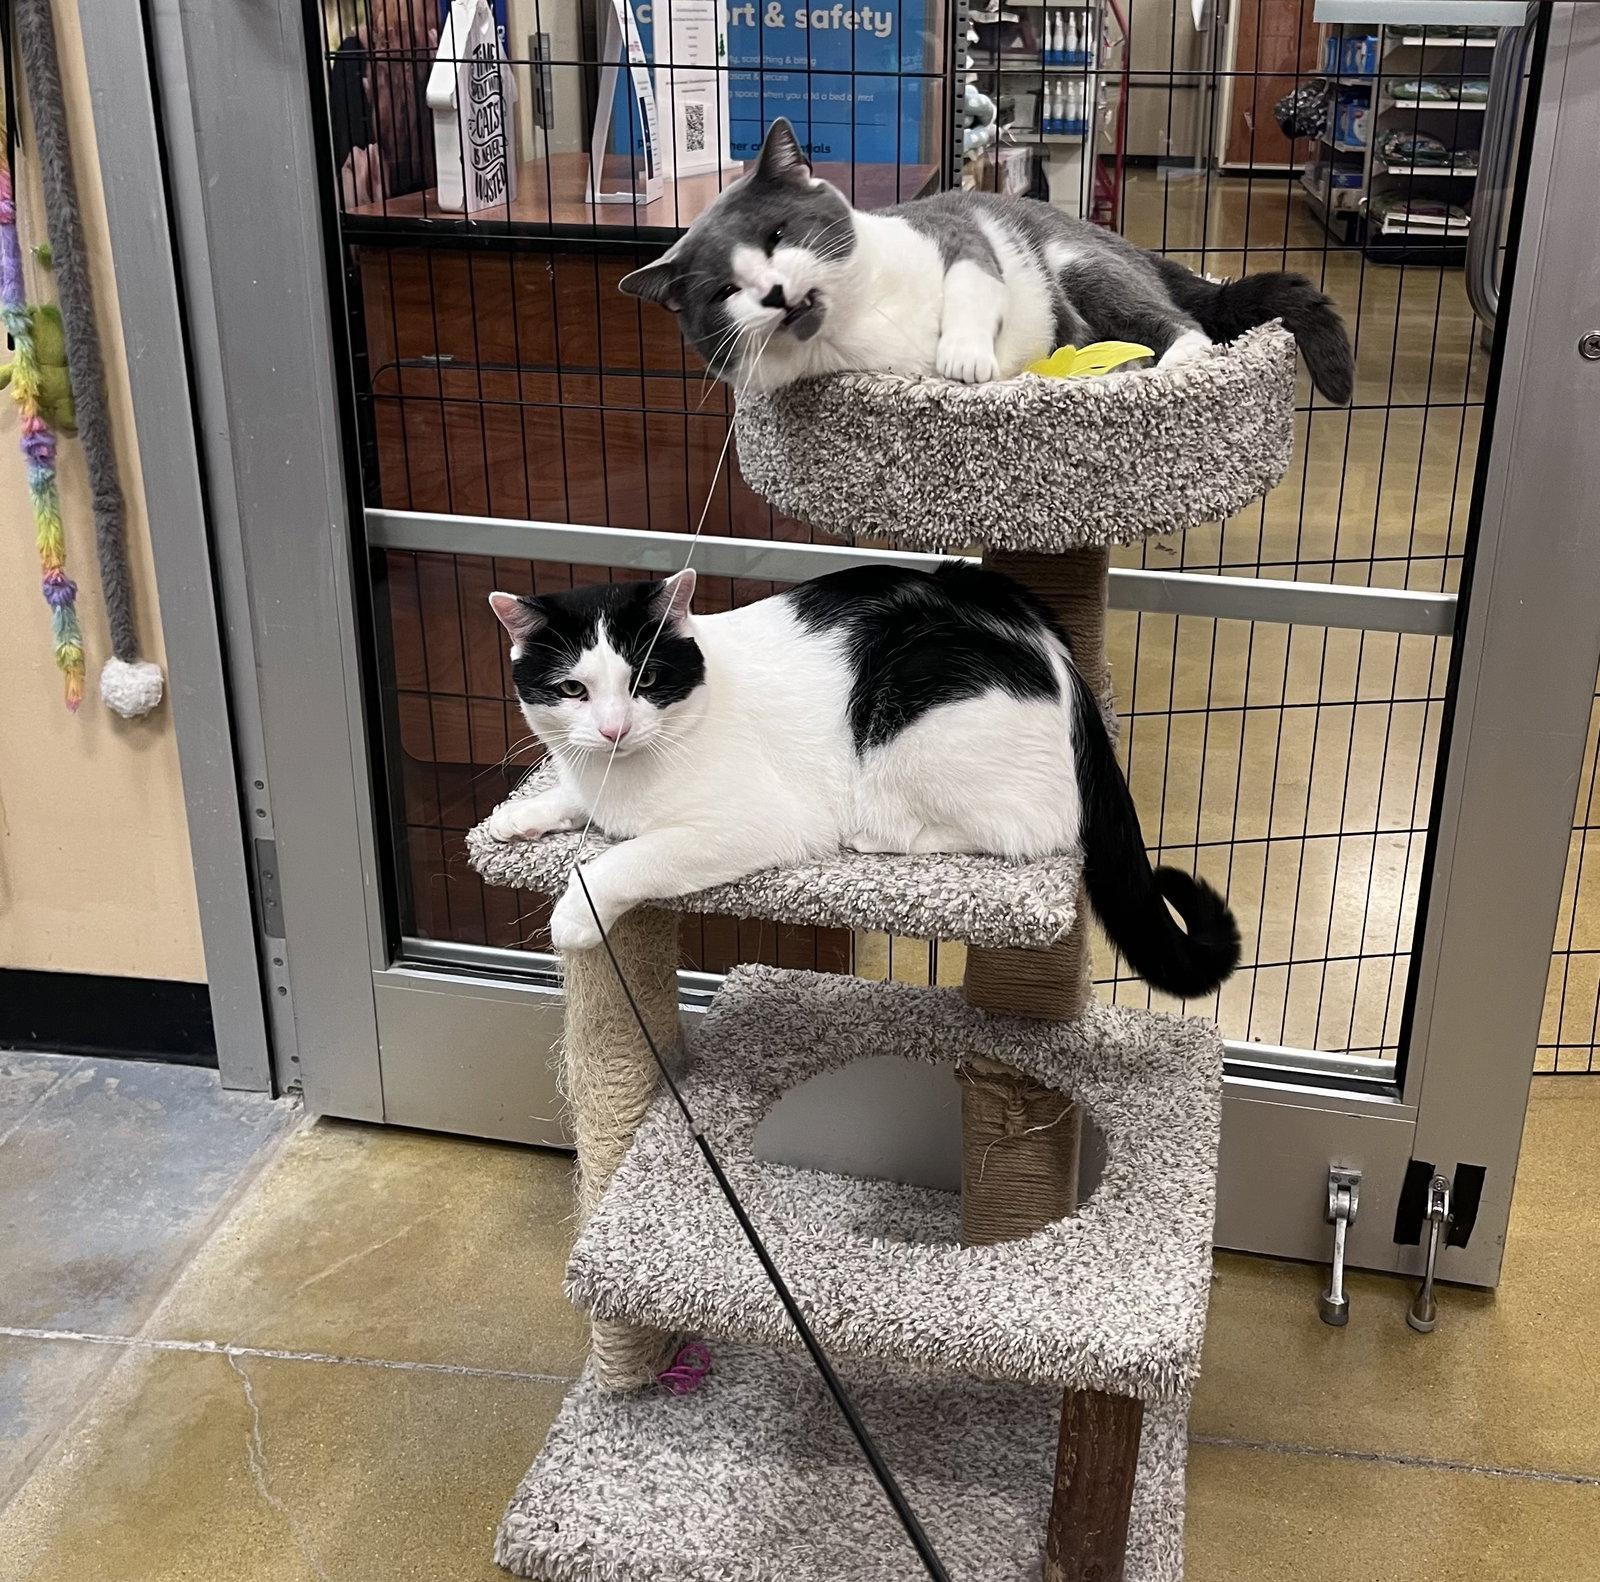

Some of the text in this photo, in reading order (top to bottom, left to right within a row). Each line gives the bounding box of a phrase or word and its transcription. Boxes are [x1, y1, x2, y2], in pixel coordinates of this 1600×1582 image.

[764, 2, 785, 28] &
[795, 4, 893, 38] safety
[742, 56, 784, 67] scraching
[476, 102, 500, 139] CATS
